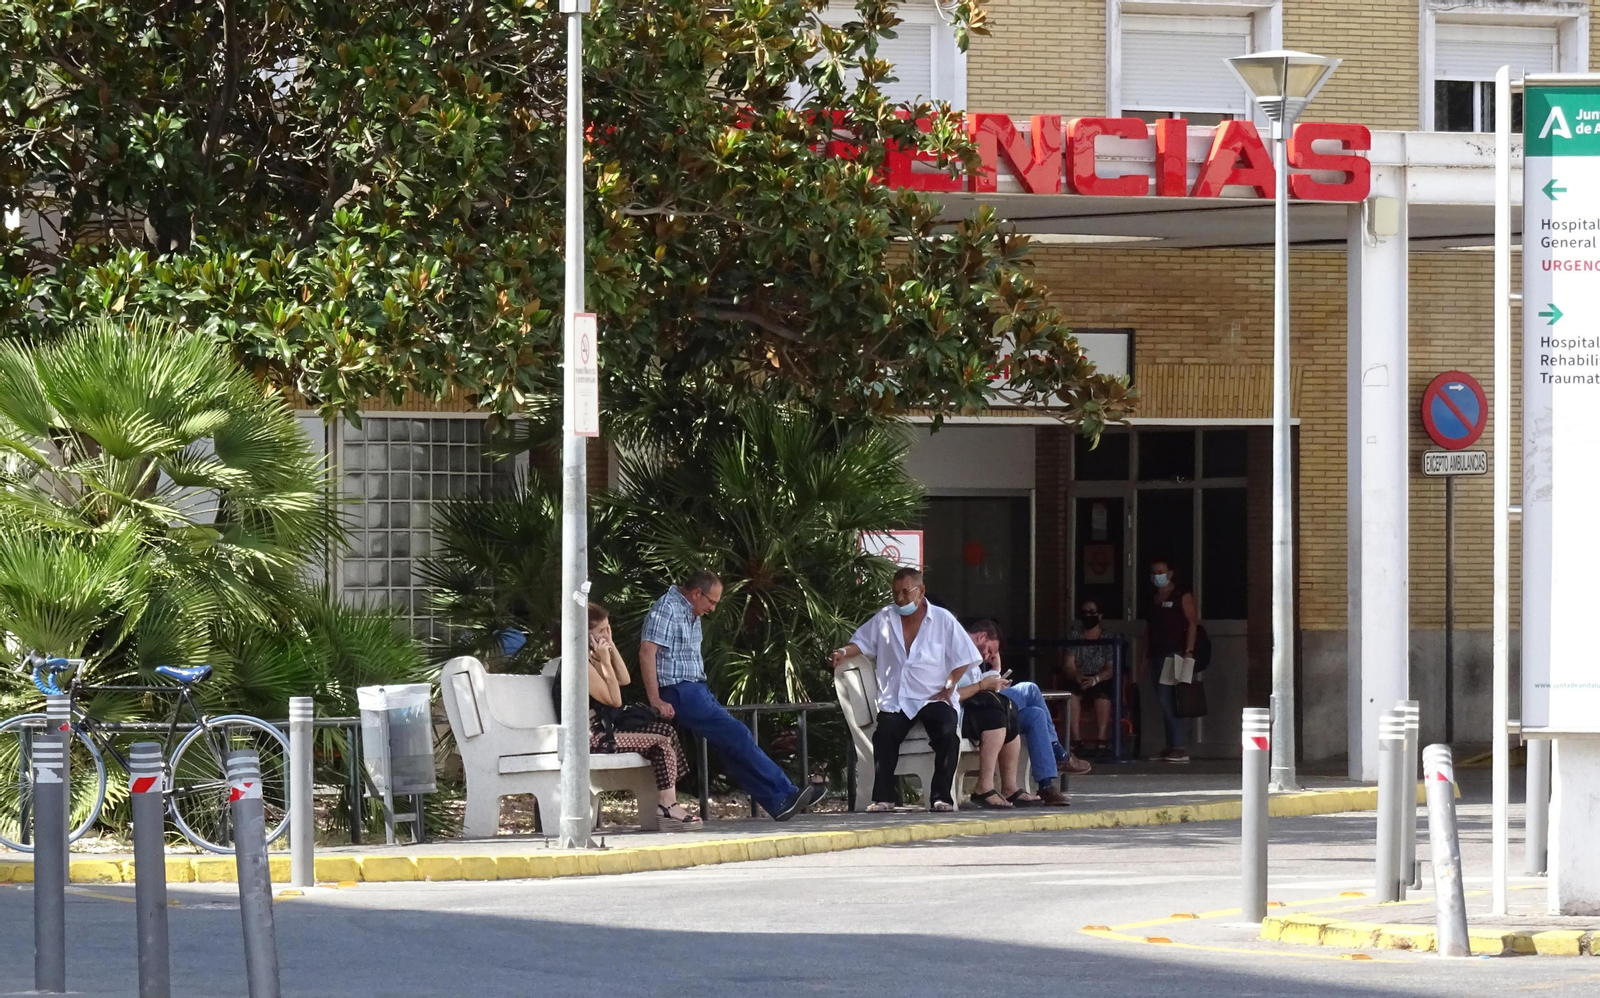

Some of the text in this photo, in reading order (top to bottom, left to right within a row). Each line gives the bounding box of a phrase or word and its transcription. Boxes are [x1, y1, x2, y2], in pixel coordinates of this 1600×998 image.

[1575, 109, 1600, 121] Jun
[1575, 122, 1592, 134] de
[1541, 218, 1600, 233] Hospital
[1541, 236, 1596, 248] General
[1542, 259, 1600, 272] URGENC
[1541, 336, 1600, 350] Hospital
[1541, 354, 1600, 367] Rehabili
[1540, 372, 1600, 384] Traumat
[1426, 454, 1485, 472] EXCEPTO AMBULANCIAS
[1534, 682, 1600, 690] wwwjuntadeandalu
